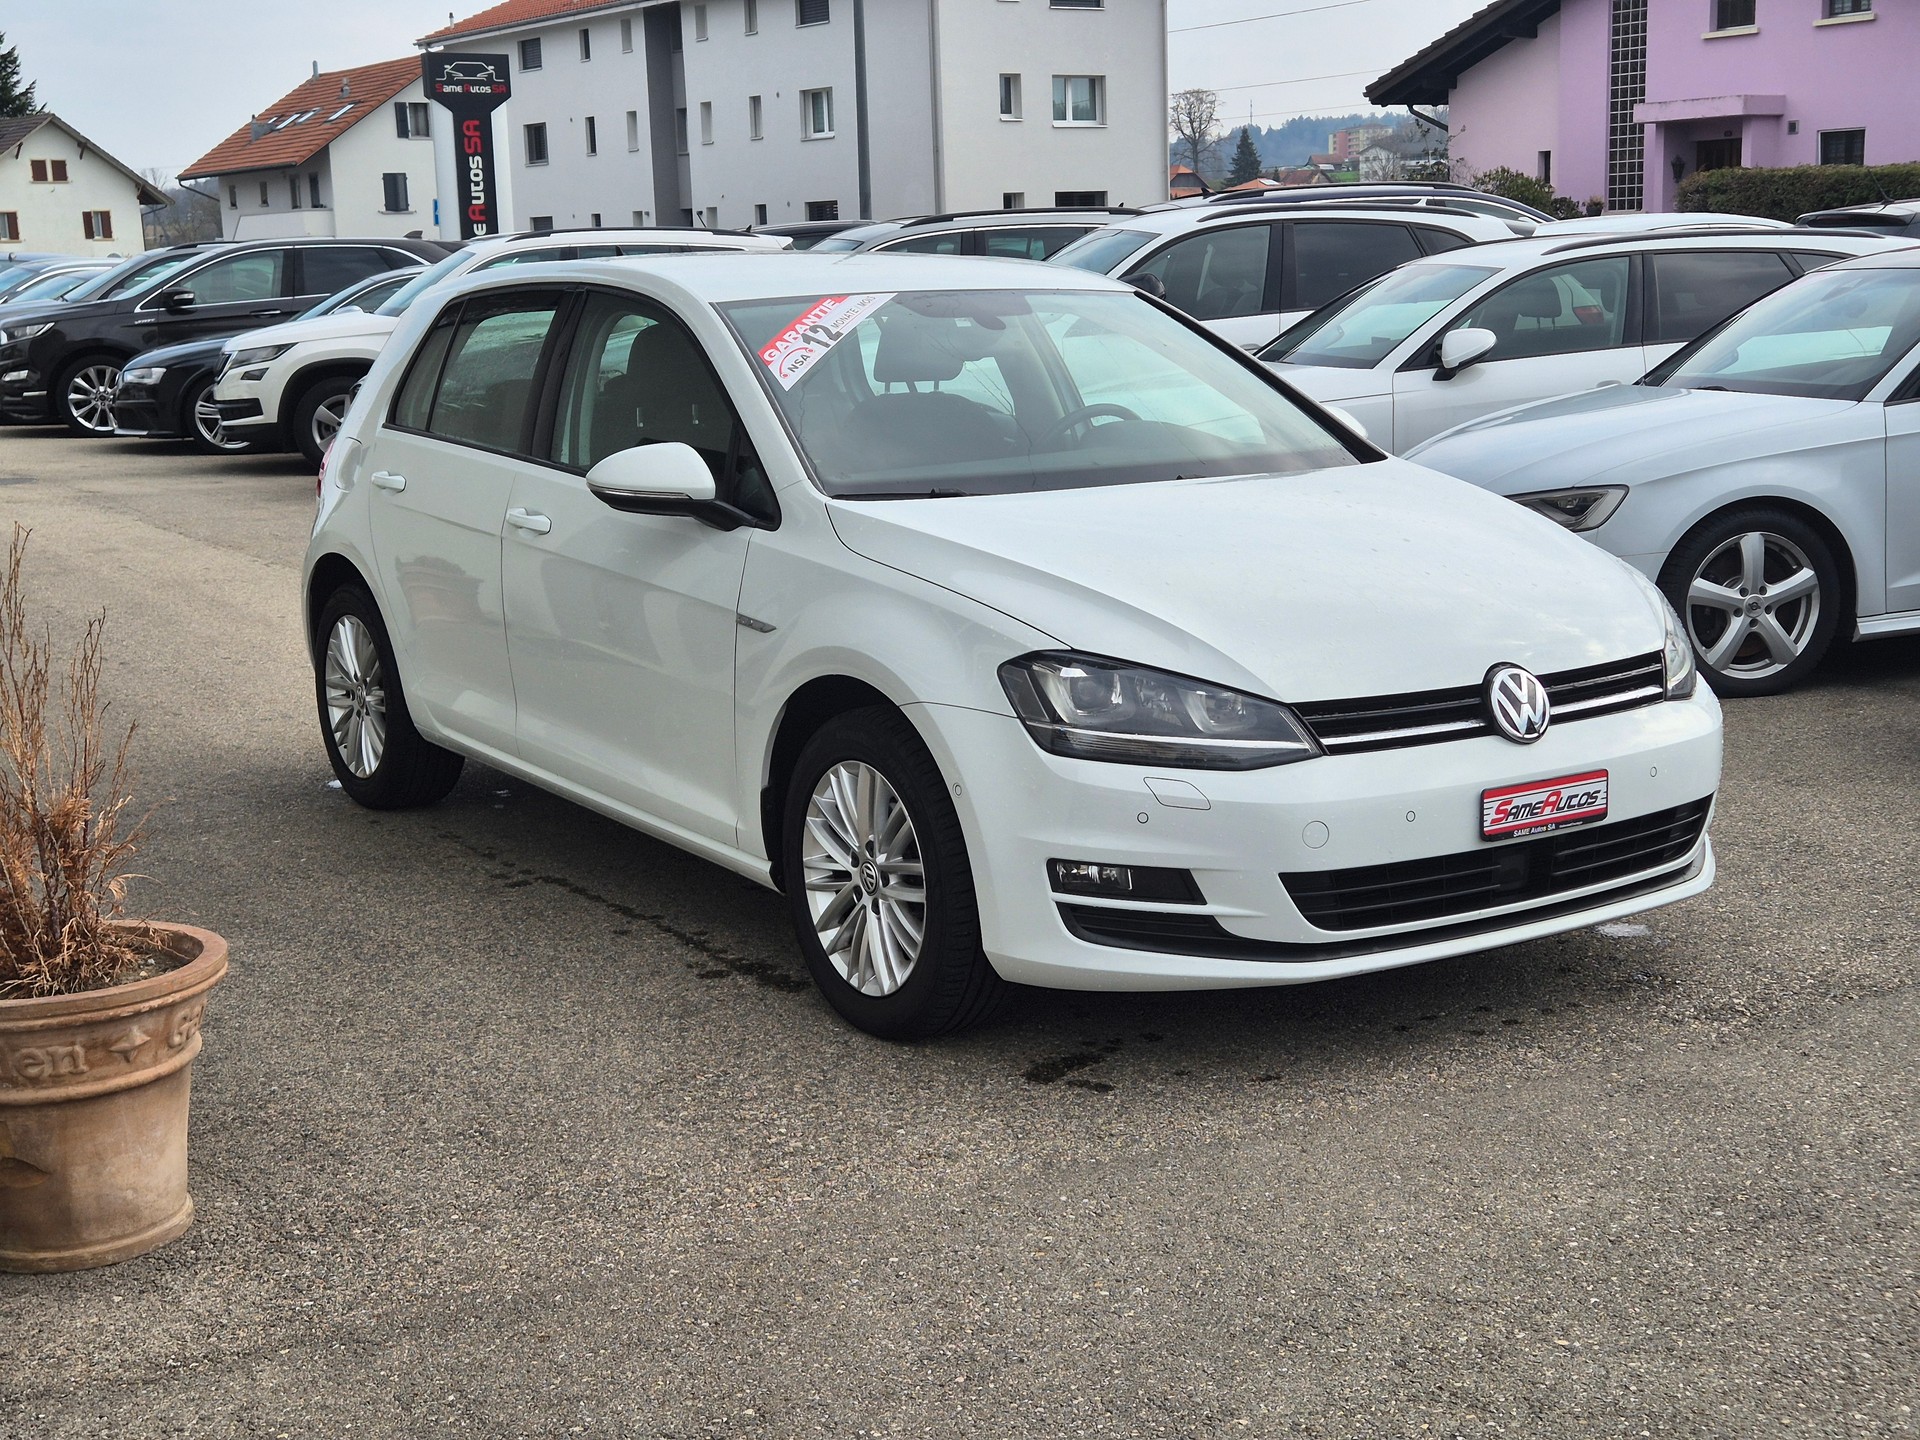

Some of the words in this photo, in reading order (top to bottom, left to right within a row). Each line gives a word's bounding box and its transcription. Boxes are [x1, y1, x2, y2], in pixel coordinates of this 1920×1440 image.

[492, 84, 507, 94] SA
[463, 119, 482, 154] SA
[830, 308, 859, 329] MONATE
[763, 299, 838, 362] GARANTIE
[801, 324, 843, 348] 12
[787, 354, 811, 373] NSA
[1513, 827, 1531, 838] SAME
[1547, 823, 1556, 831] SA
